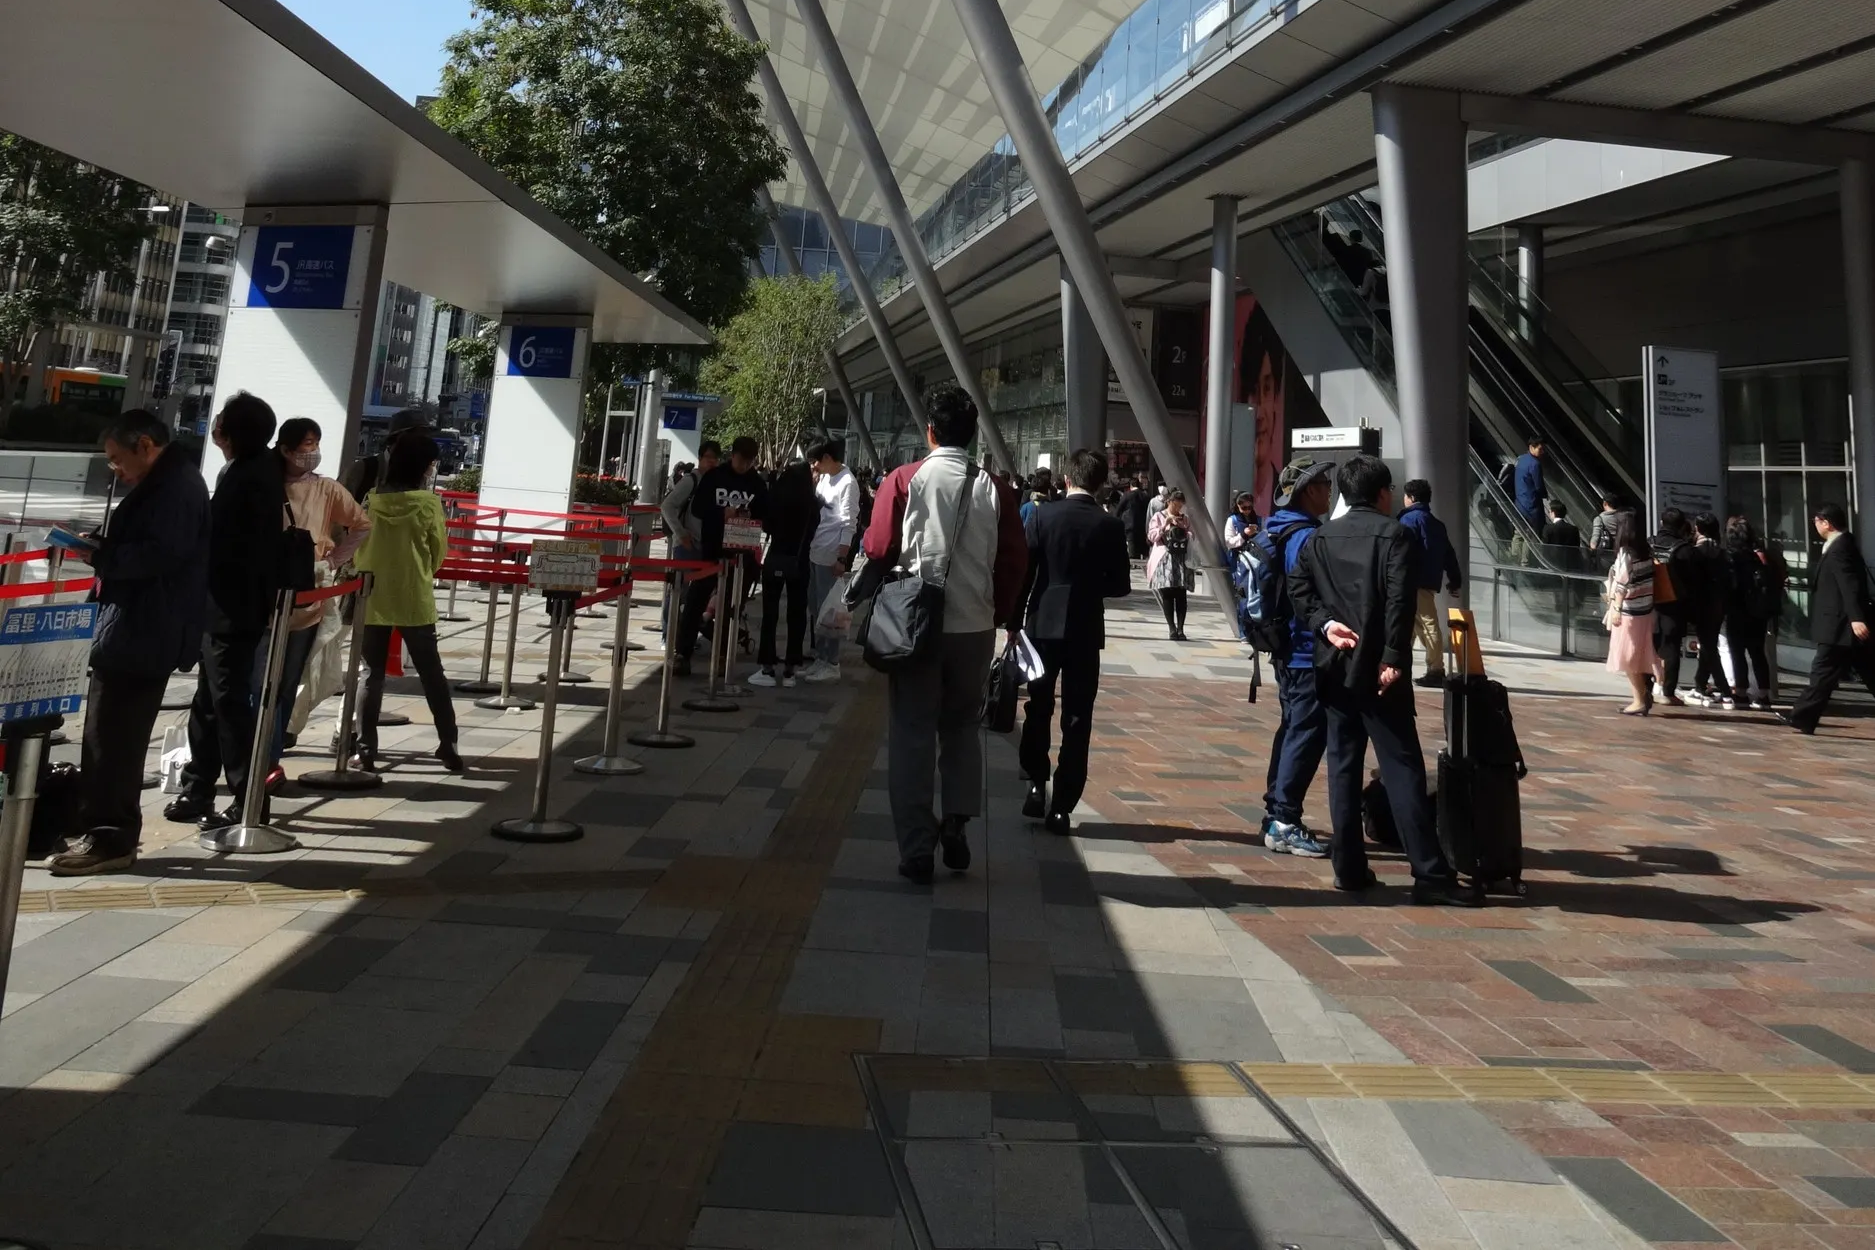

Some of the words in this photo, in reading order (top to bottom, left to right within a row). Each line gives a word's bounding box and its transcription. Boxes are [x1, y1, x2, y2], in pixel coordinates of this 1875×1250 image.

[265, 242, 294, 294] 5
[519, 336, 536, 368] 6
[670, 410, 679, 426] 7
[715, 487, 755, 510] BOY
